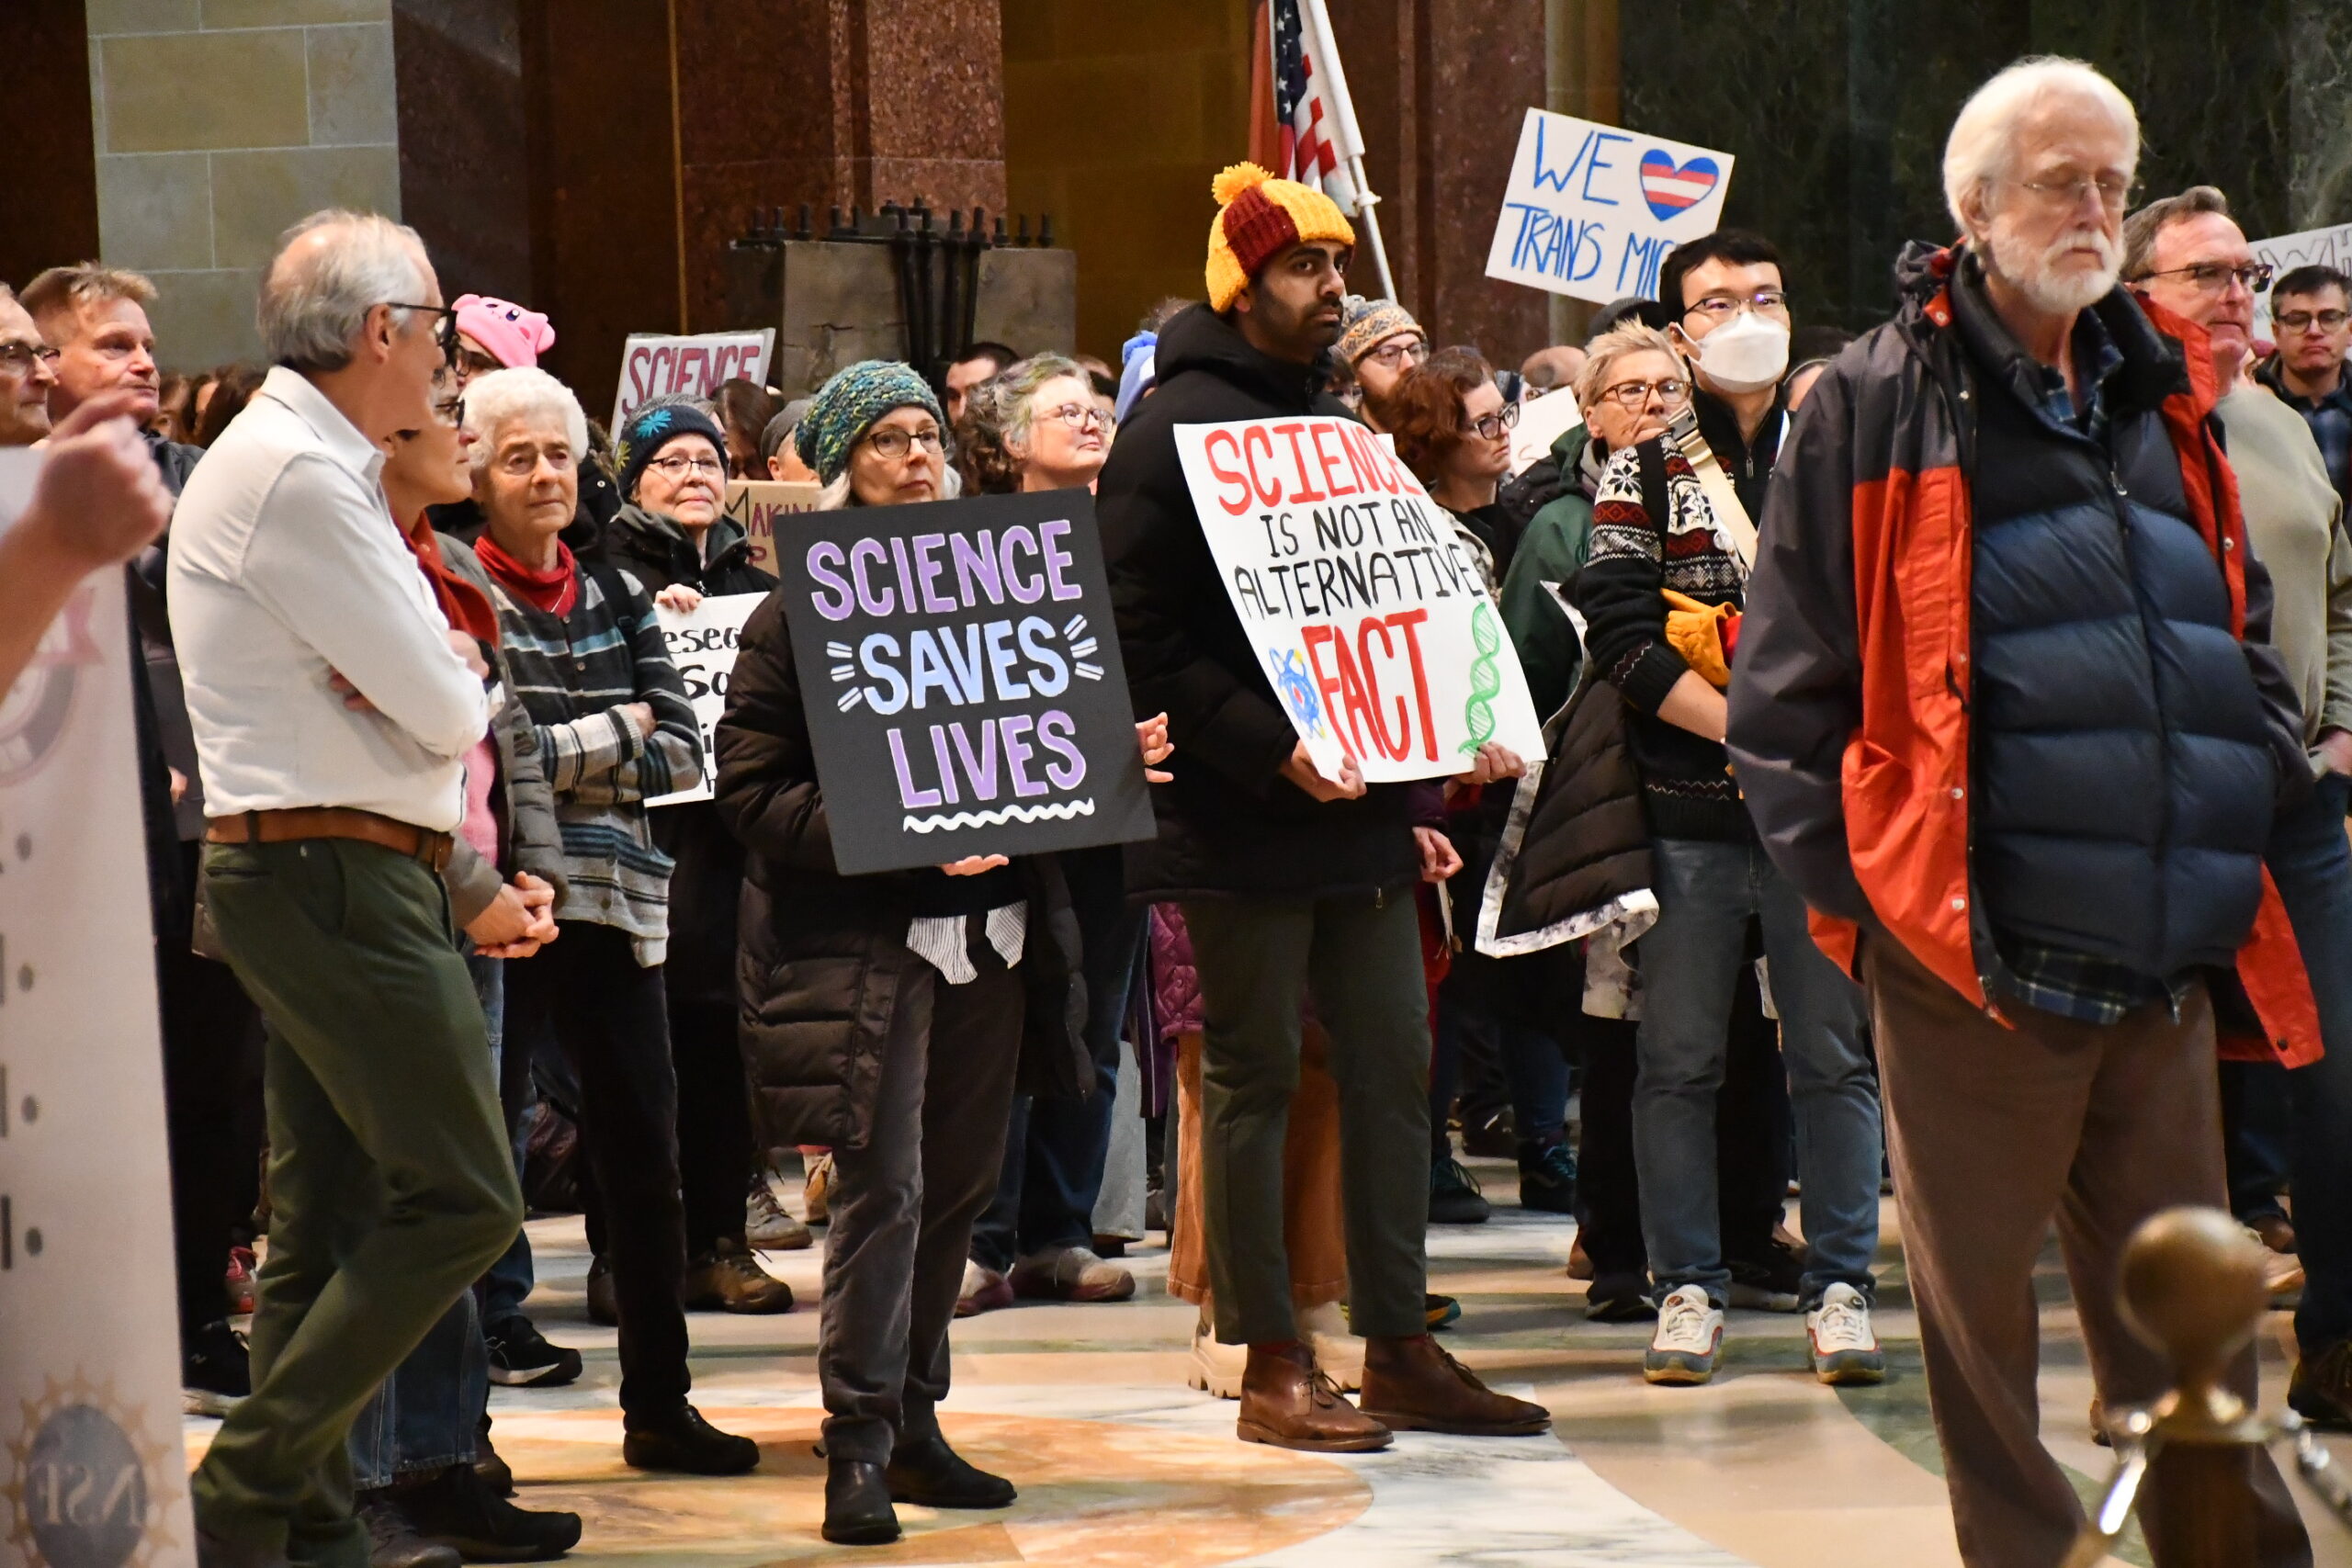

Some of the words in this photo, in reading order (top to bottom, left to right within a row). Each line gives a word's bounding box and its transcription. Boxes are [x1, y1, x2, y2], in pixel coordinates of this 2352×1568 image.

[1532, 116, 1633, 206] WE
[1505, 202, 1606, 281] TRANS
[621, 345, 761, 416] SCIENCE
[1204, 420, 1424, 516] SCIENCE
[806, 519, 1083, 622] SCIENCE
[1260, 513, 1299, 558] IS
[1312, 502, 1385, 553] NOT
[1393, 497, 1438, 546] AN
[1234, 544, 1485, 622] ALTERNATIVE
[859, 615, 1070, 716] SAVES
[1301, 607, 1440, 762] FACT
[887, 709, 1087, 809] LIVES
